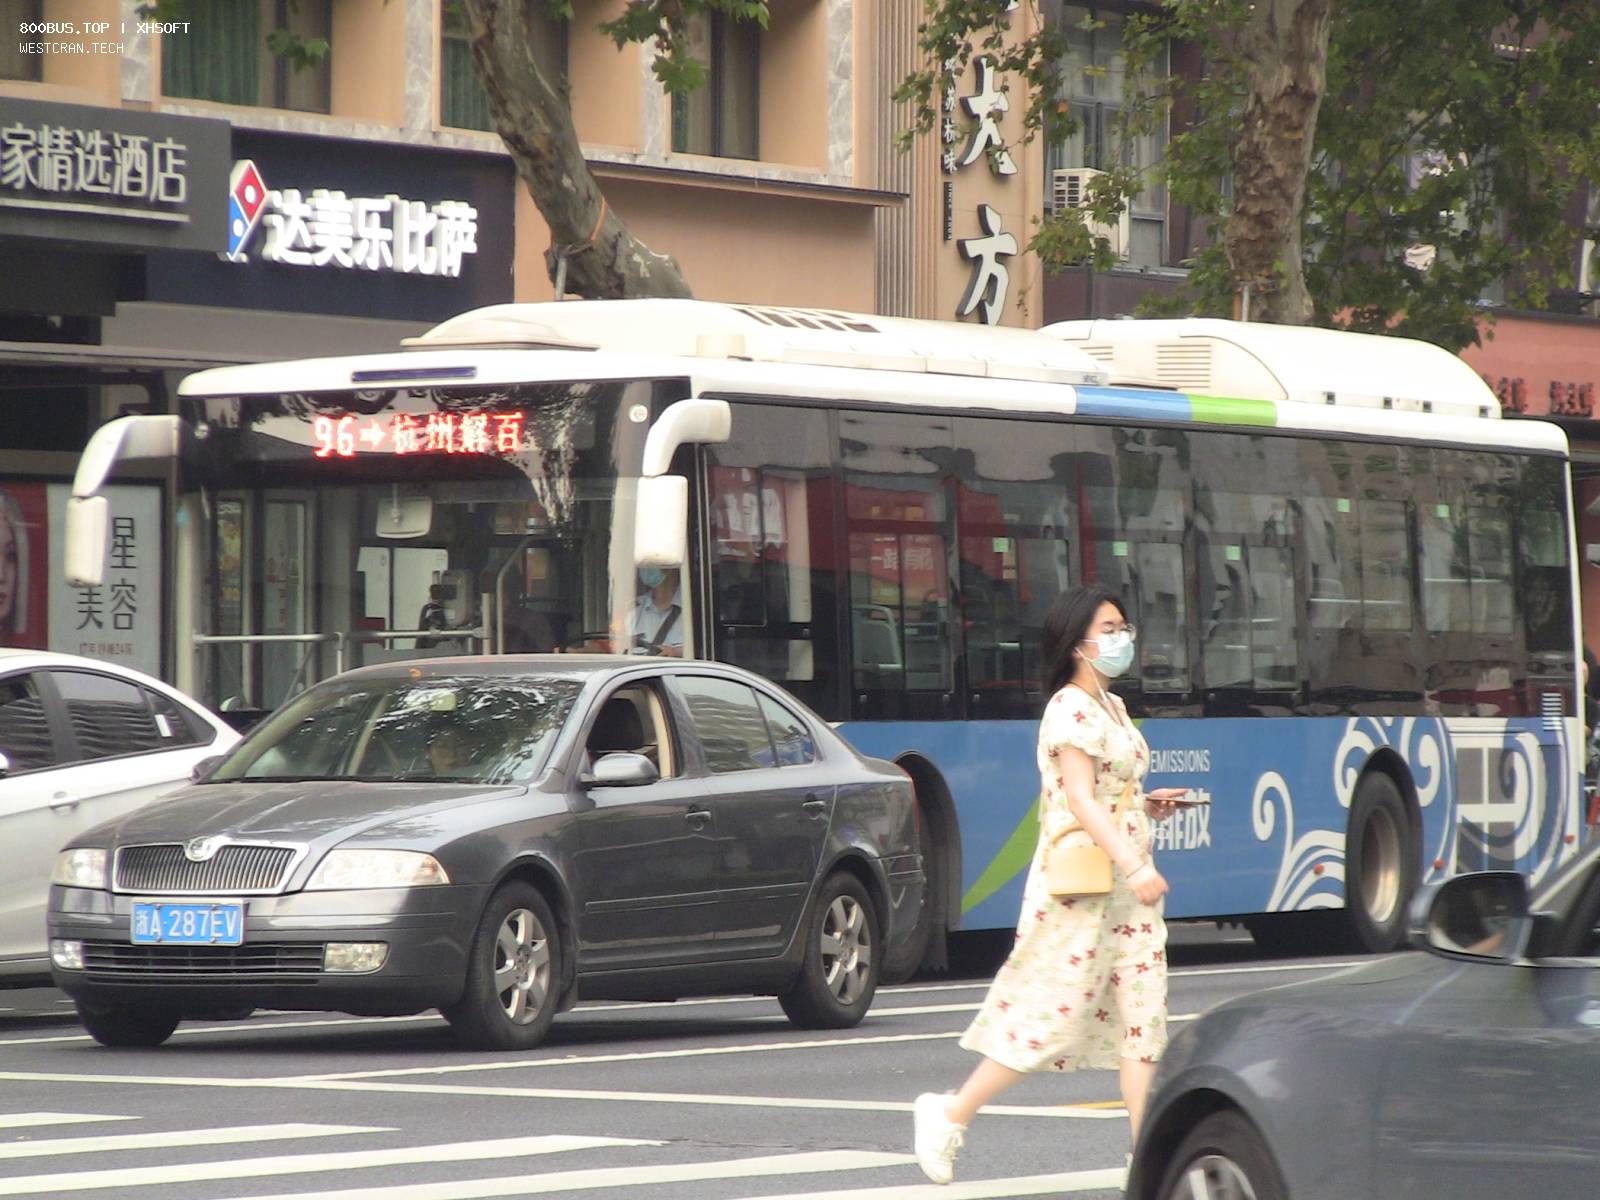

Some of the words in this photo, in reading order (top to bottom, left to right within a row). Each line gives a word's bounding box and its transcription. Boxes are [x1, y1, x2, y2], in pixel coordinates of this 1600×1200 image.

[1, 122, 188, 203] 家精选酒店
[961, 0, 1020, 326] 大方
[262, 189, 478, 278] 达美乐比萨
[315, 415, 354, 457] 96
[1150, 749, 1211, 773] EMISSIONS
